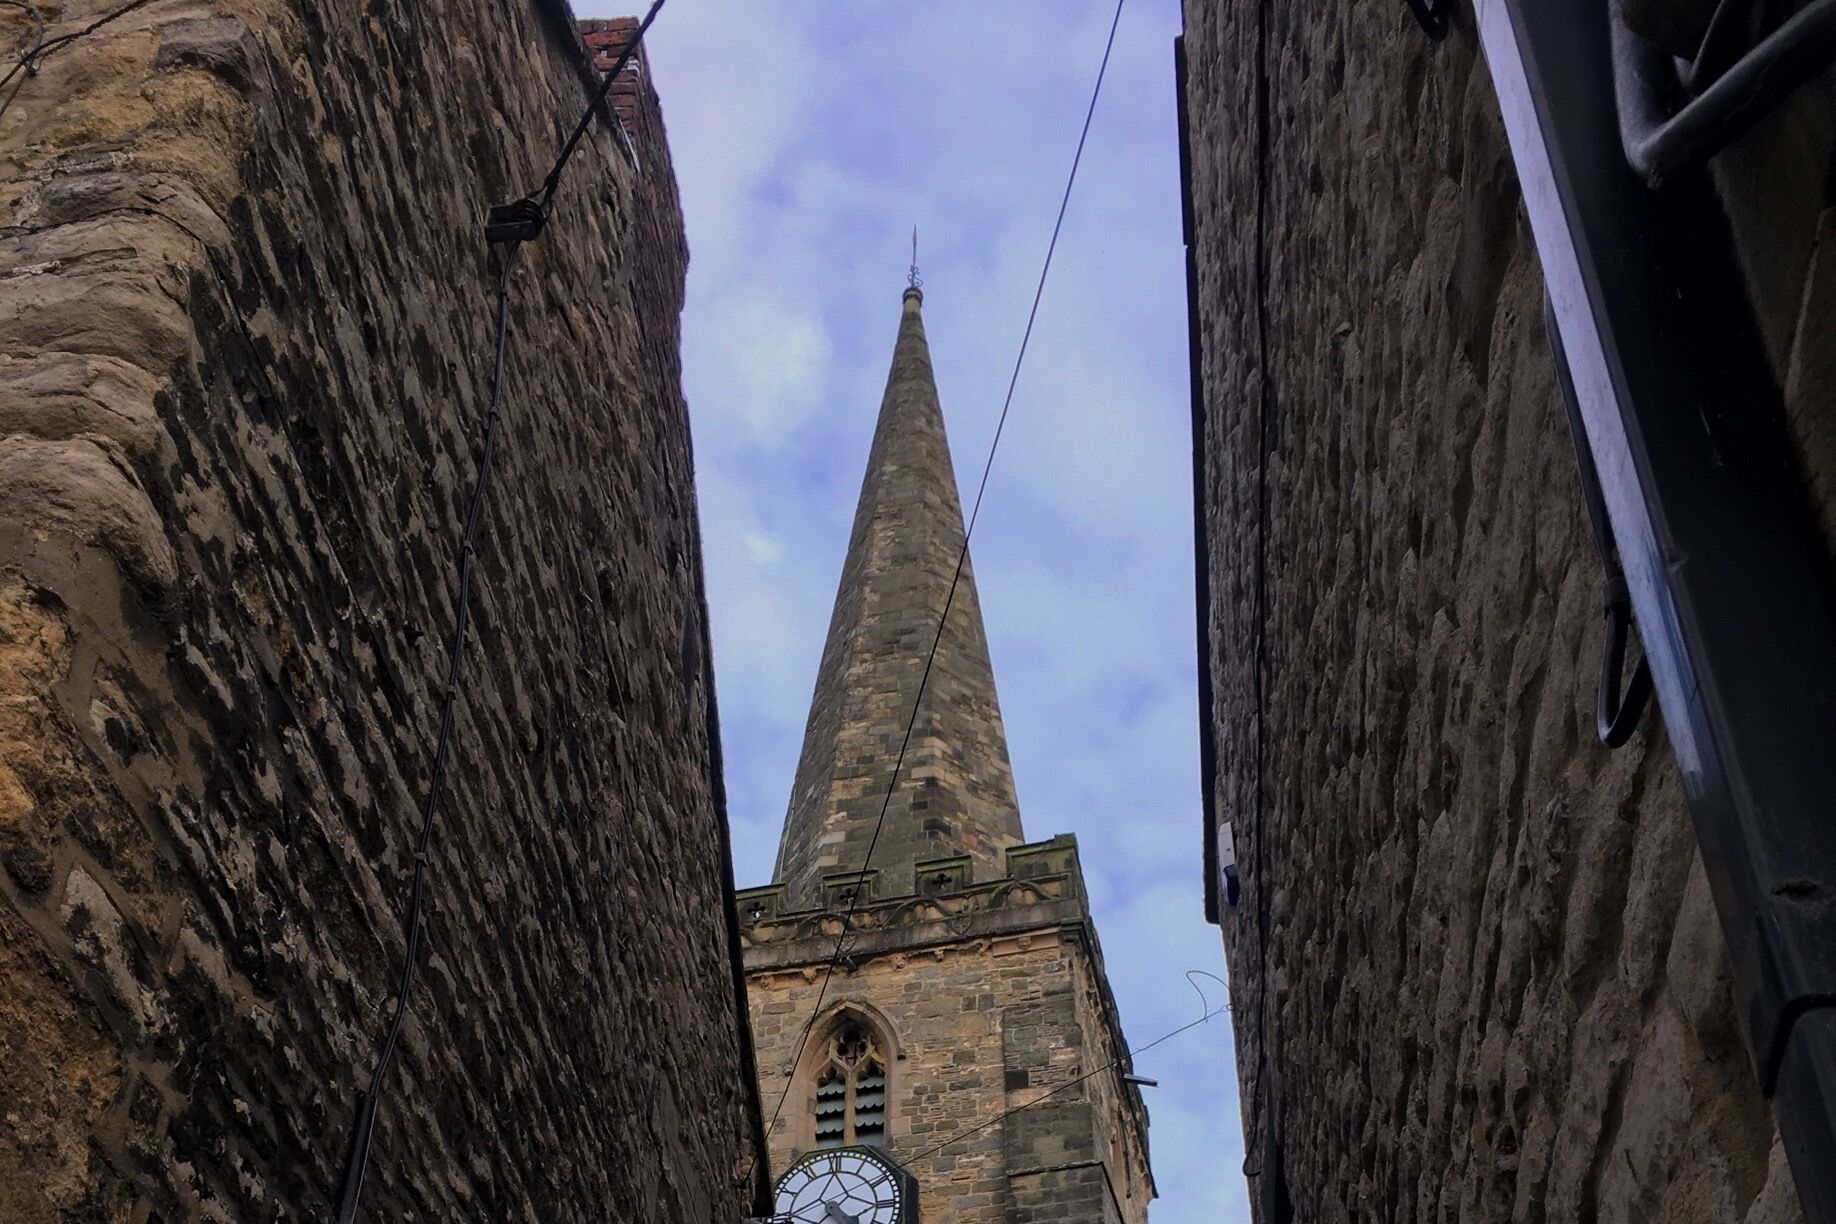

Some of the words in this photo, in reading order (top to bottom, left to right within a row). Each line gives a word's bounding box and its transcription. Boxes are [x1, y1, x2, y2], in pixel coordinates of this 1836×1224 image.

[828, 1156, 841, 1173] XII
[856, 1161, 866, 1175] I
[800, 1165, 816, 1181] XI
[869, 1174, 888, 1188] II
[876, 1200, 895, 1209] III
